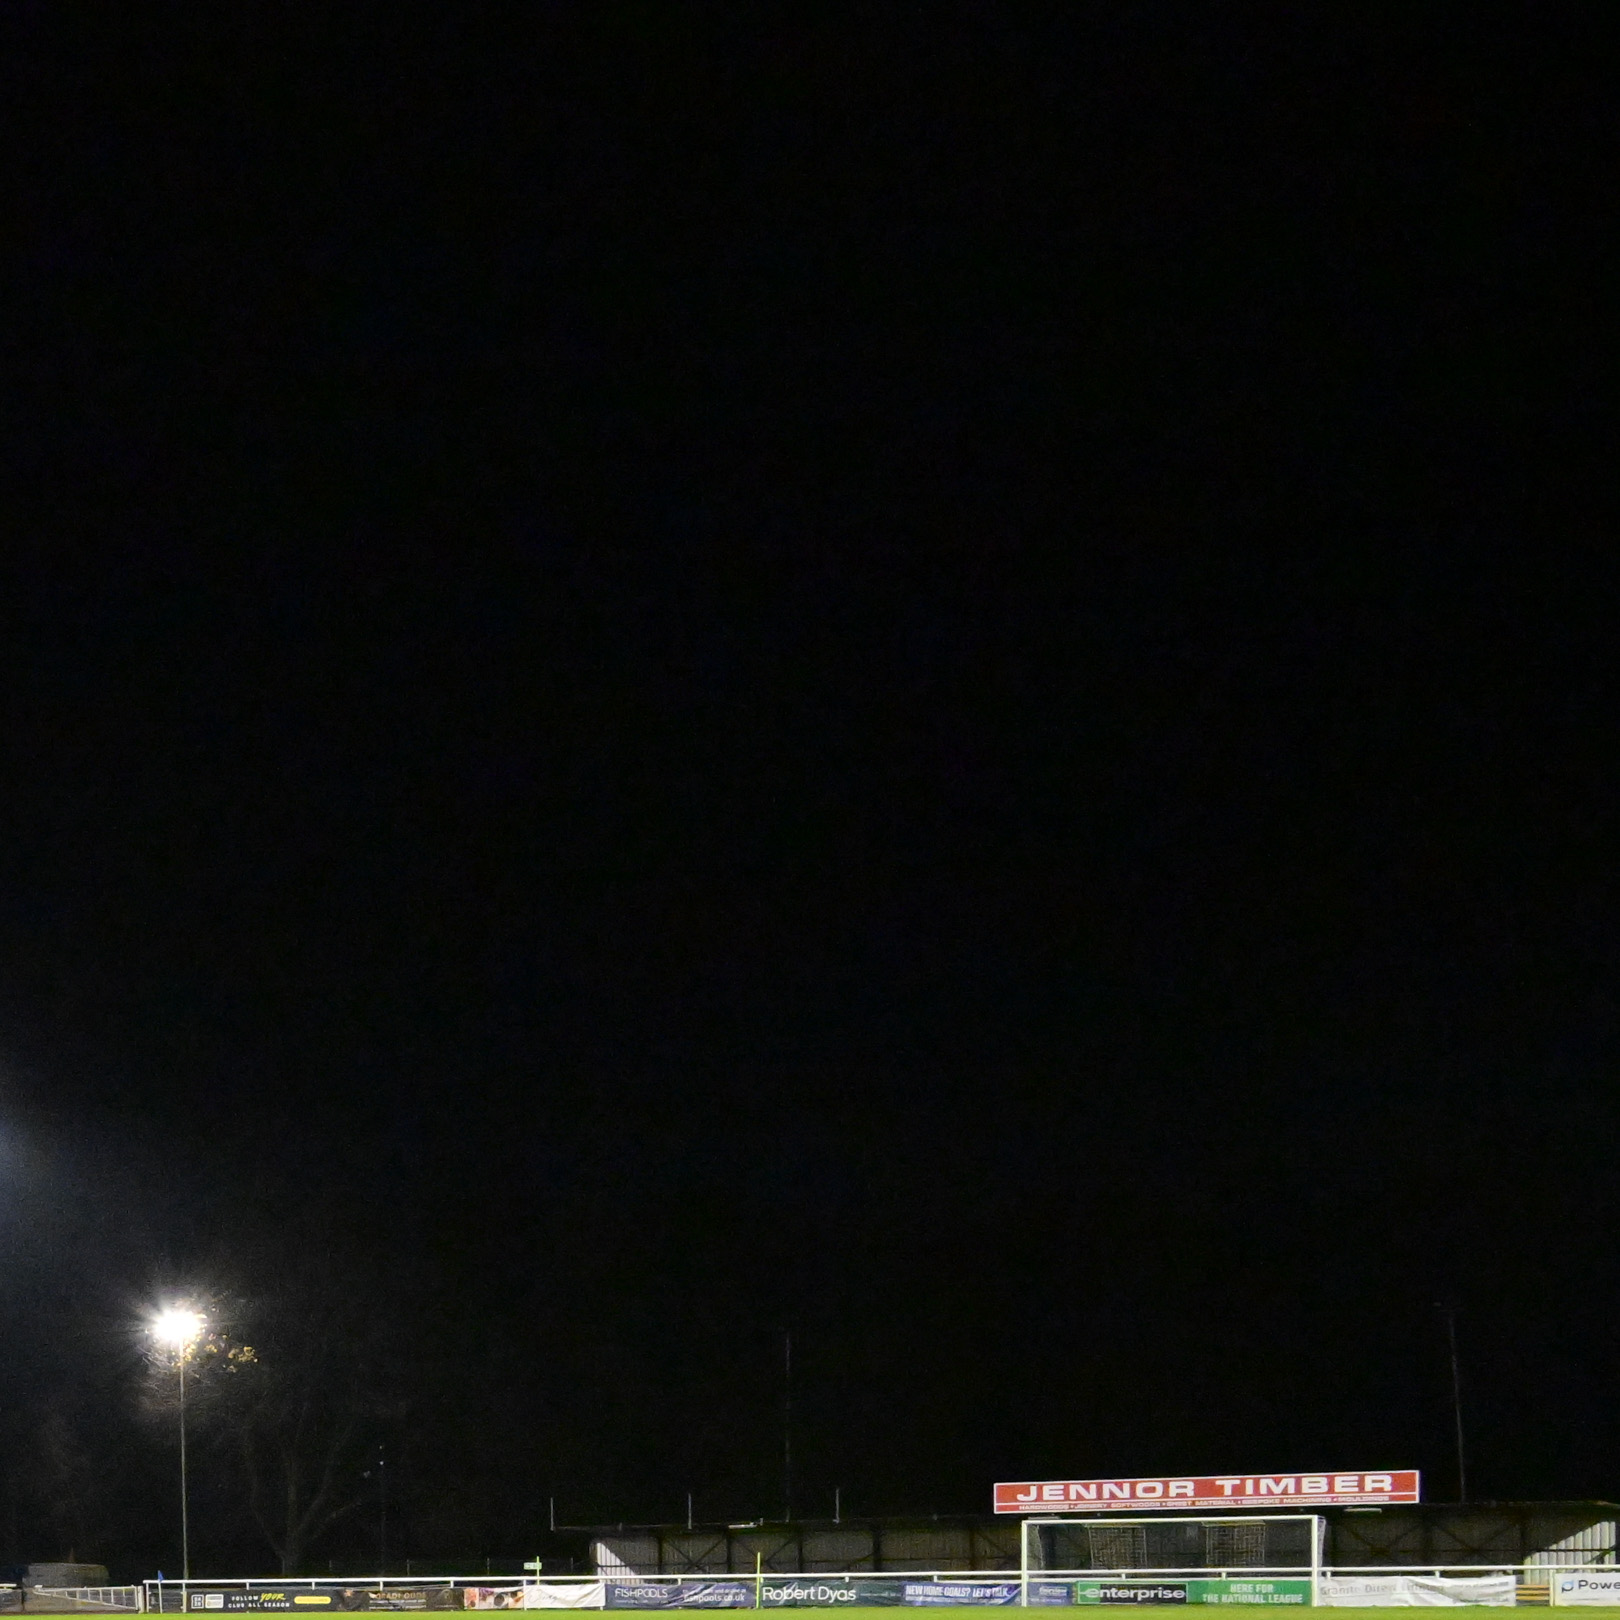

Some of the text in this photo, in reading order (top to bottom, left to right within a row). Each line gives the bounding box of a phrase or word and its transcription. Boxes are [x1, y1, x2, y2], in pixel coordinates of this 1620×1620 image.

[1016, 1474, 1393, 1502] JENNOR TIMBER
[615, 1588, 668, 1598] FISHPOOLS
[905, 1585, 923, 1595] NEW
[1230, 1584, 1274, 1593] HERE FOR
[762, 1587, 857, 1603] Robert Dyas
[1085, 1587, 1186, 1601] enterprise
[1221, 1593, 1265, 1603] NATIONAL
[1268, 1594, 1303, 1603] LEAGUE
